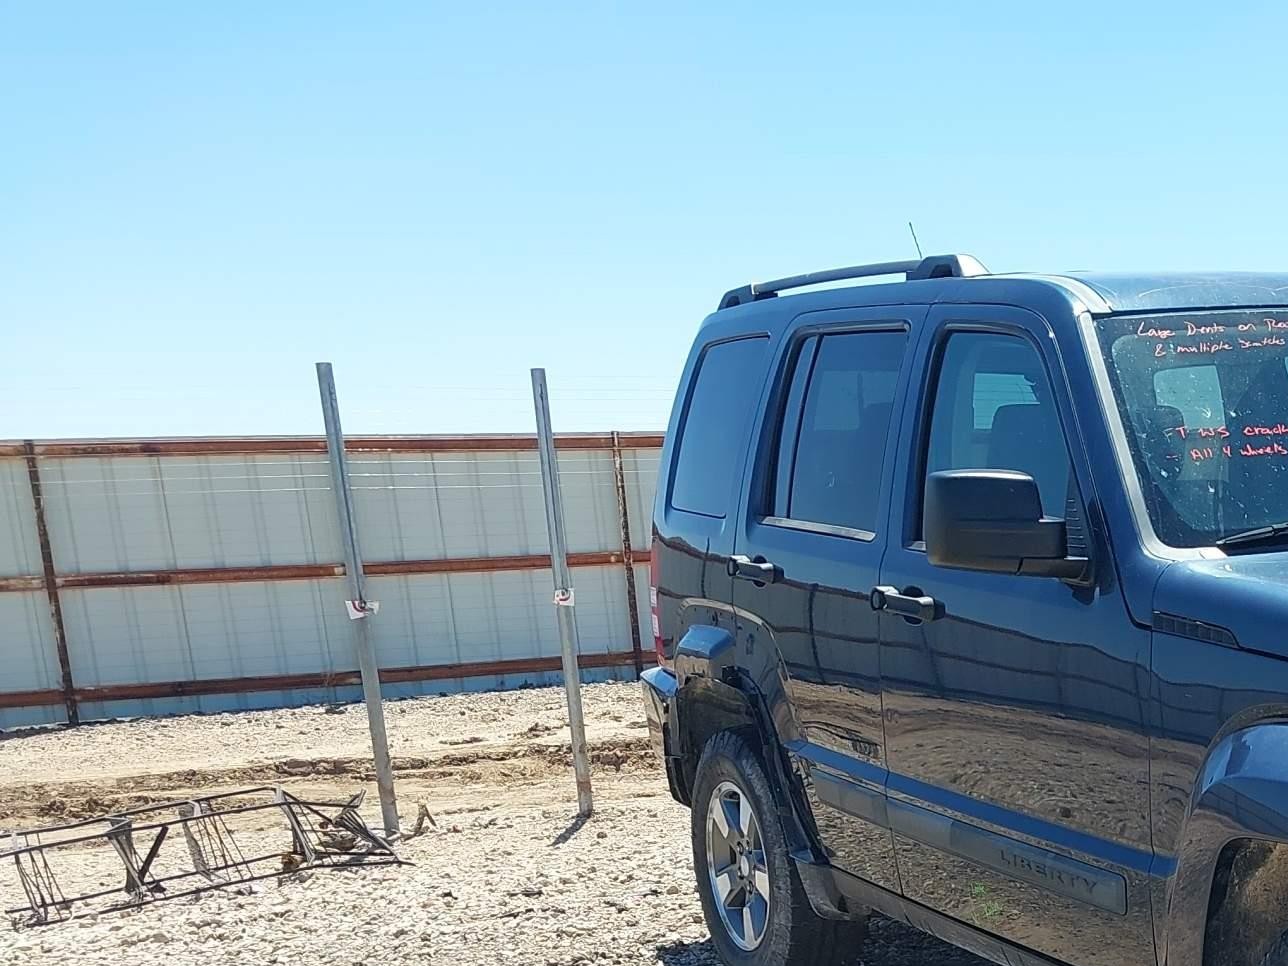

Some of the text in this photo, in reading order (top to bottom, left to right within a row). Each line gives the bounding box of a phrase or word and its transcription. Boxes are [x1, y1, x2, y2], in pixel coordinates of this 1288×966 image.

[1184, 321, 1226, 336] Dents
[1238, 323, 1257, 332] on
[1176, 341, 1232, 353] multiple
[1190, 447, 1213, 461] All
[1222, 445, 1232, 458] 4
[1000, 849, 1099, 894] LIBERTY
